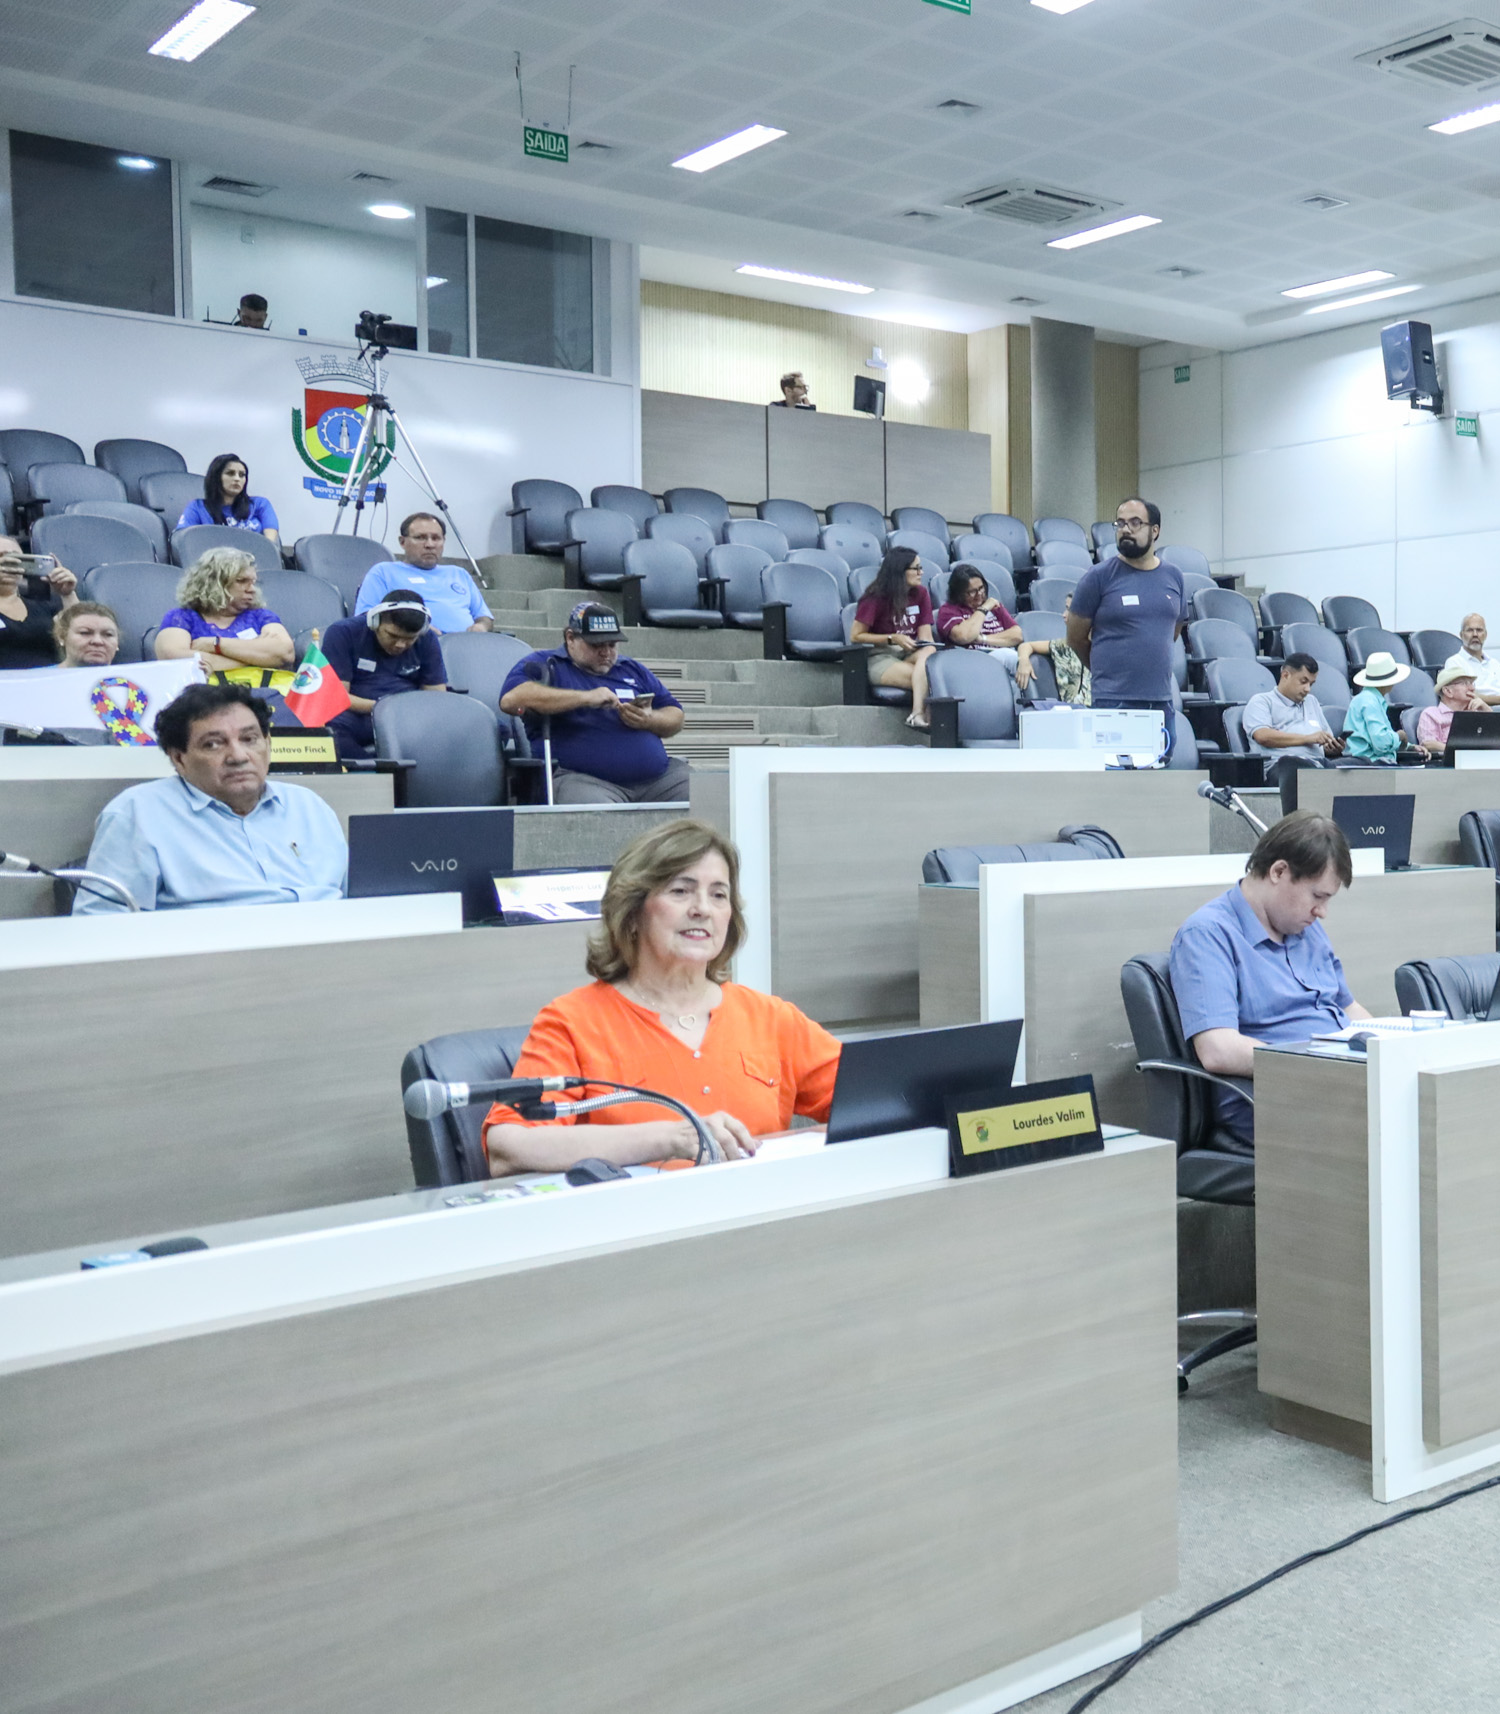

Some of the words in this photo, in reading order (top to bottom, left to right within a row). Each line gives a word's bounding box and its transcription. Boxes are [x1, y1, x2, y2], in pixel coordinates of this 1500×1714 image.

[304, 745, 327, 753] Finck
[1361, 825, 1386, 836] VAIO
[410, 858, 458, 873] VAIO
[1012, 1115, 1055, 1131] Lourdes
[1055, 1108, 1086, 1124] Valim
